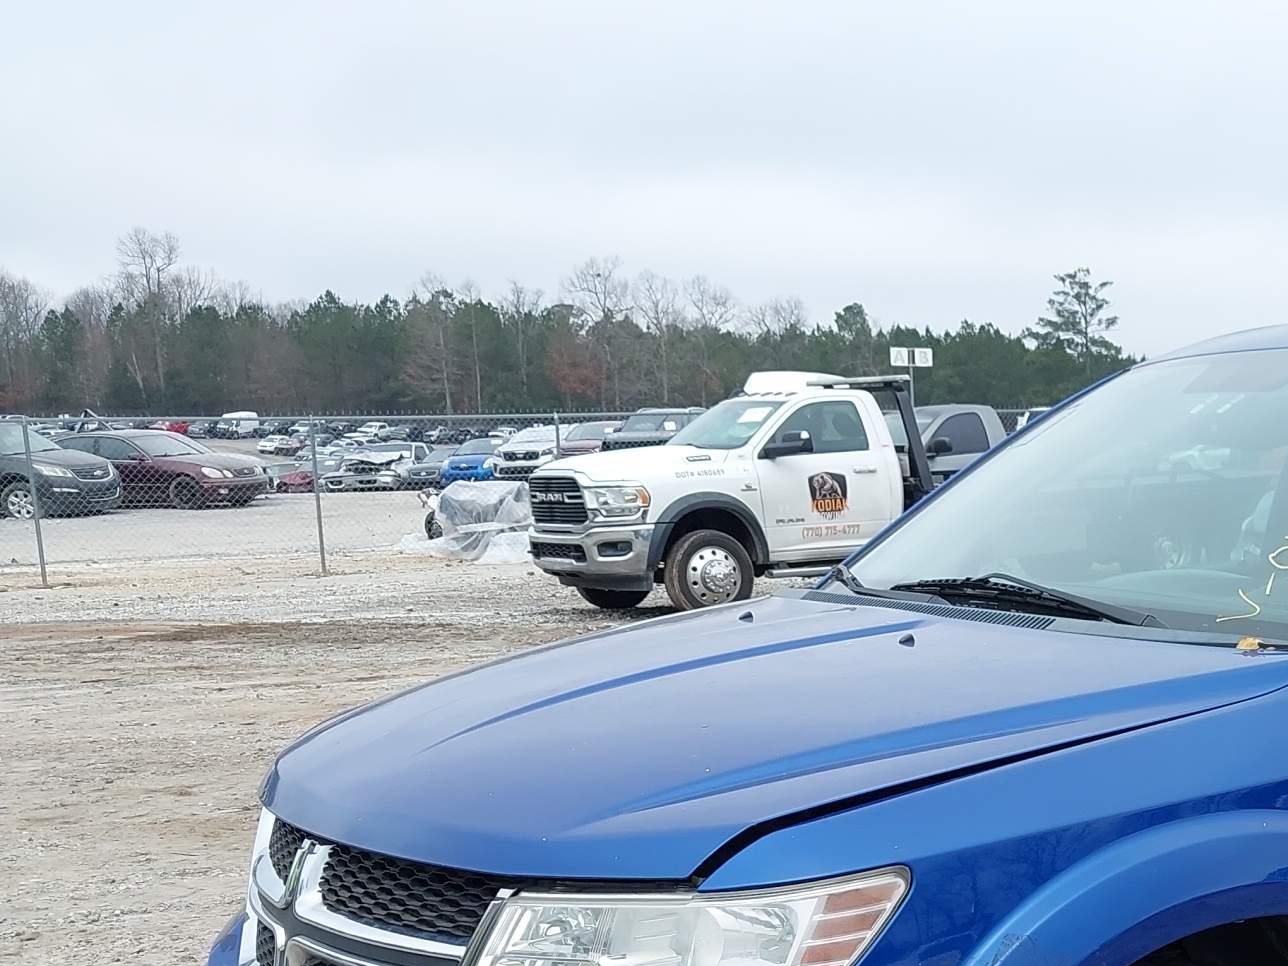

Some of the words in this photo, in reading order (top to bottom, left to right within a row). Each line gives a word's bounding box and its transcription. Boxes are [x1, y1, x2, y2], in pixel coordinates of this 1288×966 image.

[894, 350, 906, 364] A
[919, 351, 929, 364] B
[810, 497, 850, 513] KODIAK
[802, 527, 822, 539] (770)
